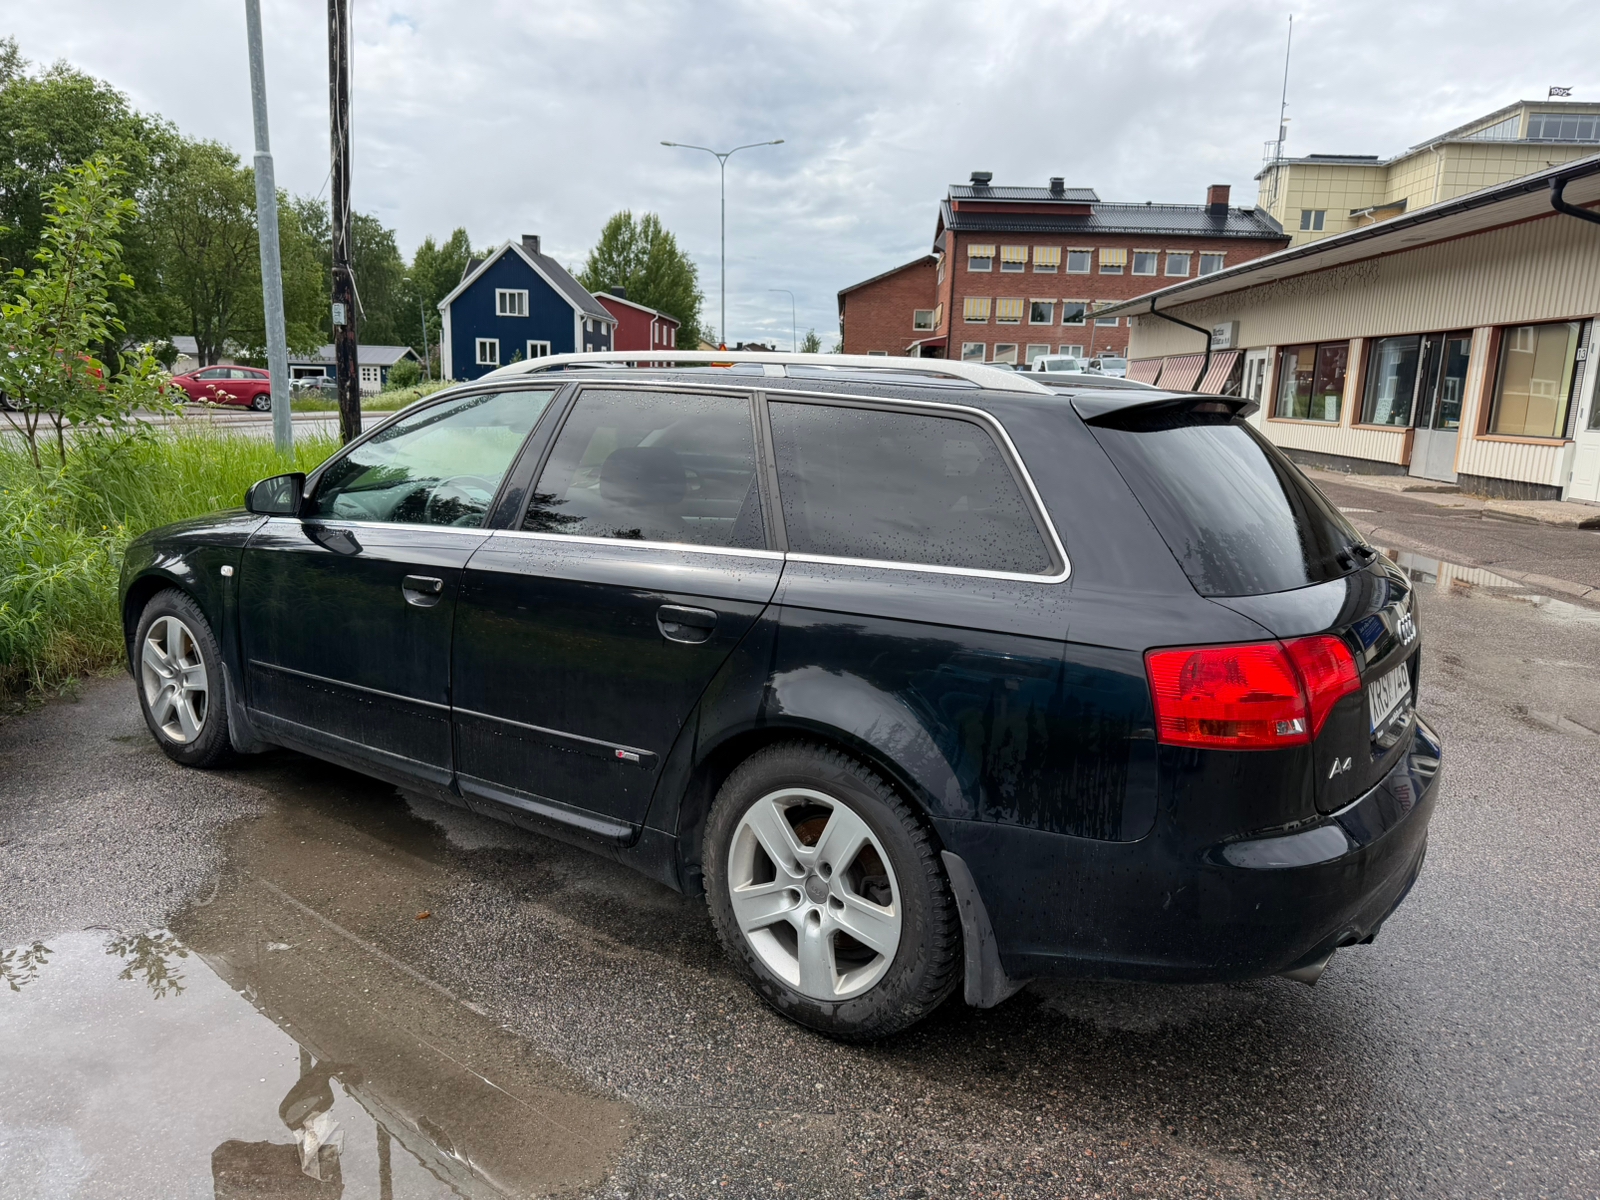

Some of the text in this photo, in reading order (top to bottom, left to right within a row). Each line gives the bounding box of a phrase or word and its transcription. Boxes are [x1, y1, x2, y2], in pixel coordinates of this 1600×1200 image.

[1551, 87, 1567, 97] 1992
[1578, 349, 1586, 359] 13
[1369, 675, 1389, 722] XRS
[1328, 757, 1352, 779] A4
